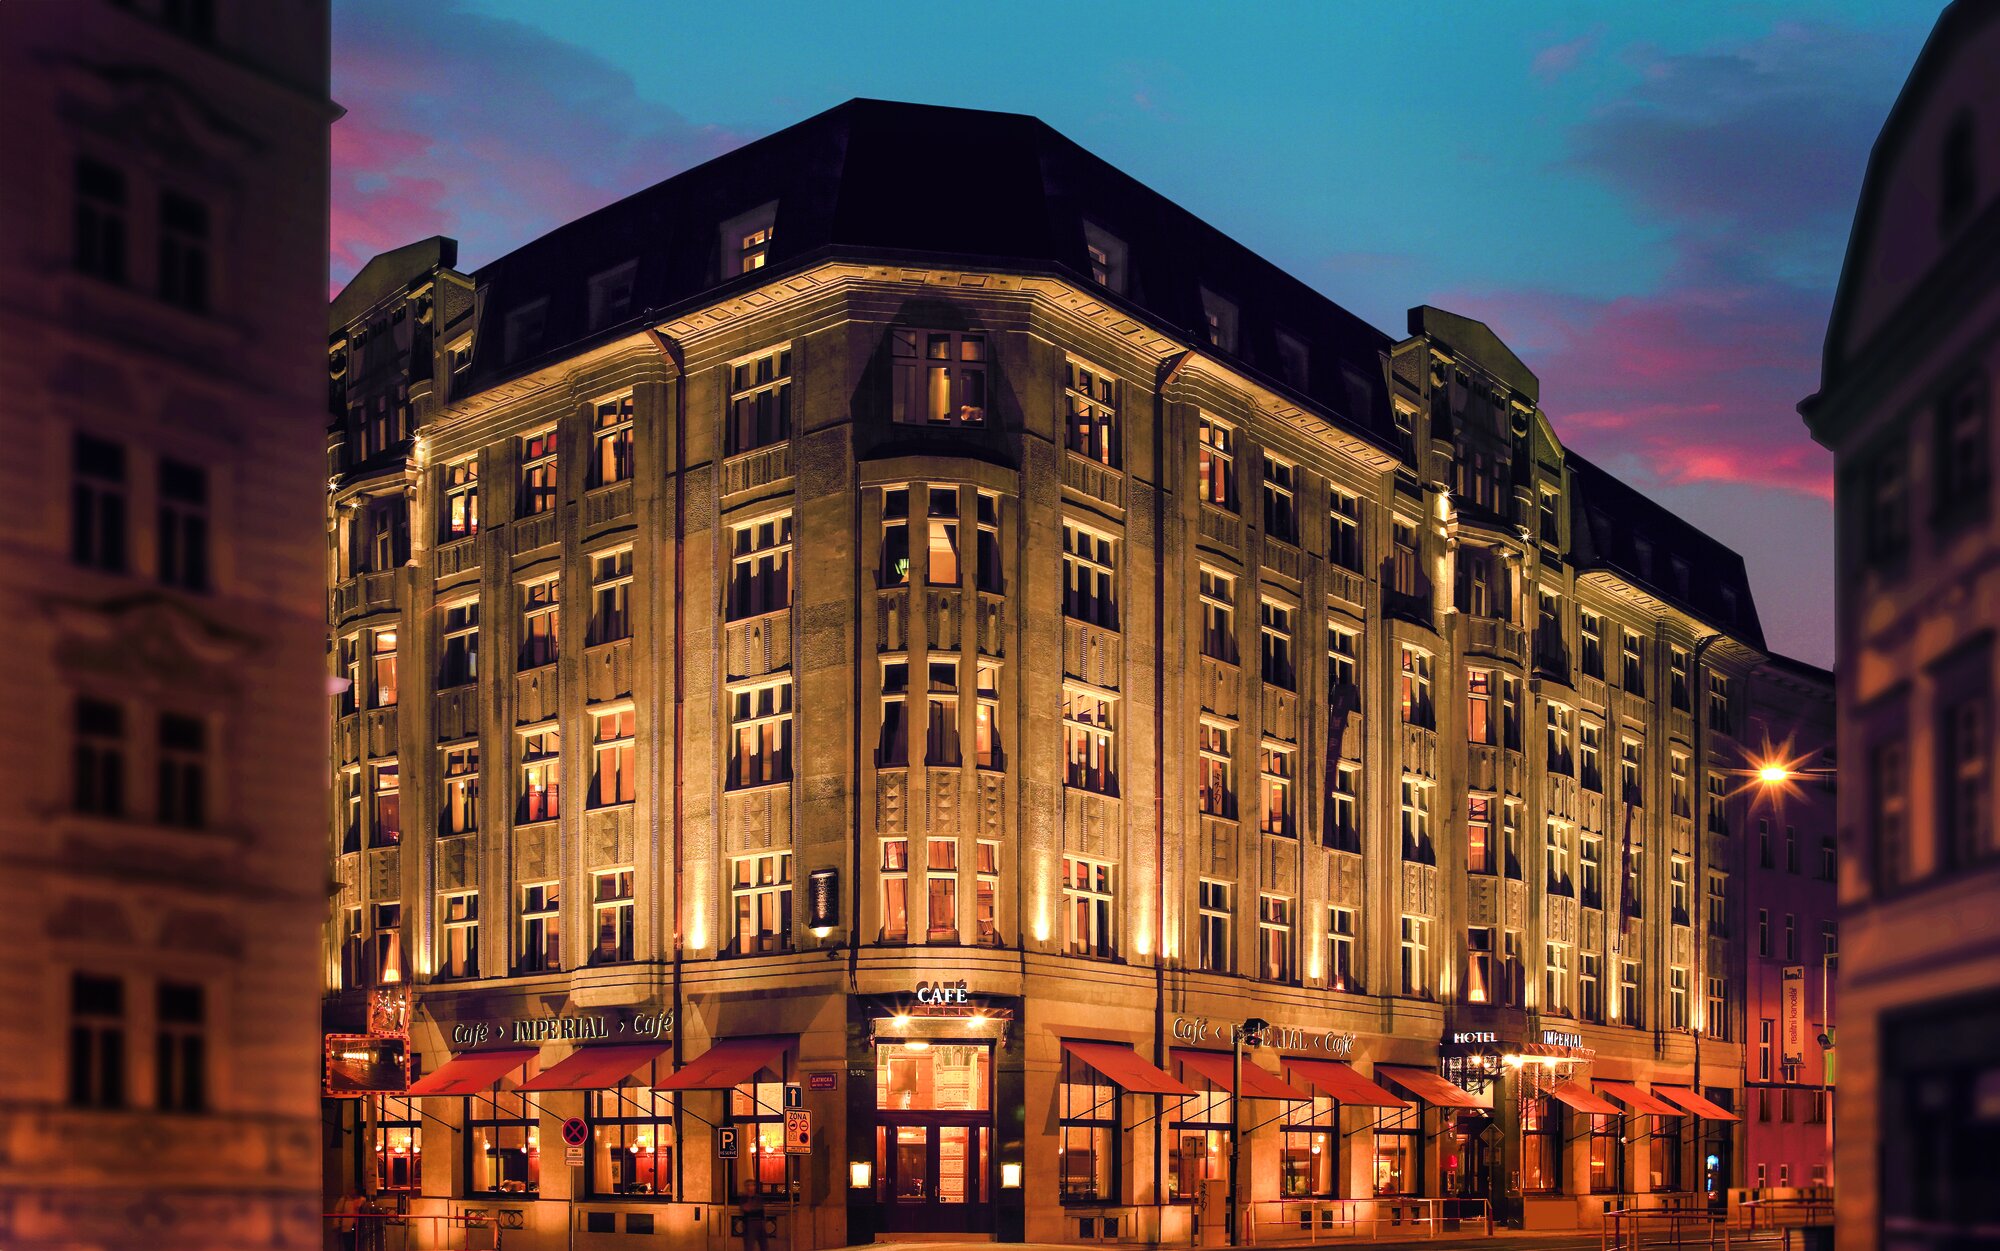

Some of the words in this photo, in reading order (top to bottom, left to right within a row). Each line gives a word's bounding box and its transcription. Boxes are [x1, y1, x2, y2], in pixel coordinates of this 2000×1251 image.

[917, 984, 968, 1003] CAFÉ
[452, 1022, 489, 1048] Café
[512, 1016, 609, 1042] IMPERIAL
[633, 1008, 674, 1040] Café
[1173, 1017, 1209, 1045] Café
[1230, 1024, 1309, 1051] IERIAL
[1324, 1032, 1357, 1057] Café
[1454, 1032, 1498, 1044] HOTEL
[1543, 1030, 1584, 1048] IMPERIAL
[722, 1131, 734, 1149] P
